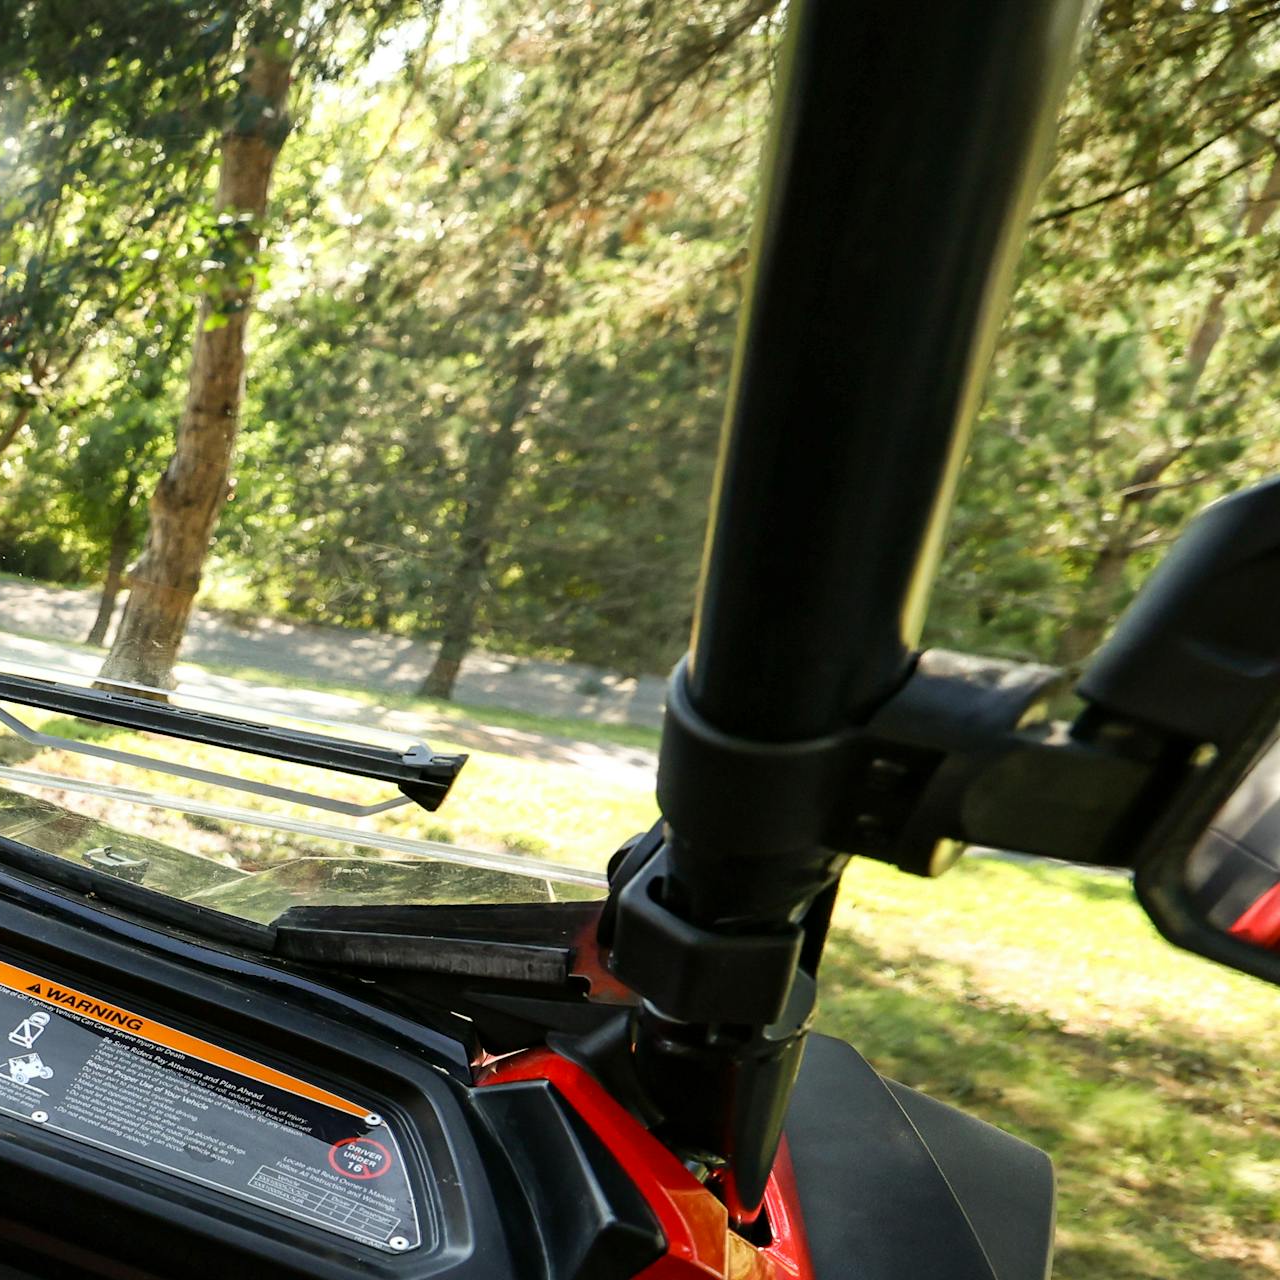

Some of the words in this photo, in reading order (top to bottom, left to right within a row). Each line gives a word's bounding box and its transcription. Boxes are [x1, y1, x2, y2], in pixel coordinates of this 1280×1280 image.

[45, 987, 145, 1032] WARNING
[55, 1007, 82, 1020] Vehicles
[81, 1017, 95, 1025] Can
[94, 1022, 115, 1033] Cause
[114, 1030, 137, 1042] Severe
[135, 1038, 156, 1050] Injury
[164, 1049, 186, 1060] Death
[85, 1059, 115, 1075] Require
[113, 1070, 139, 1084] Proper
[139, 1080, 155, 1089] Use
[153, 1085, 165, 1093] of
[163, 1089, 182, 1100] Your
[181, 1096, 209, 1111] Vehicle
[103, 1036, 114, 1044] Be
[113, 1040, 131, 1050] Sure
[130, 1047, 154, 1059] Riders
[153, 1055, 169, 1066] Pay
[168, 1060, 204, 1078] Attention
[203, 1074, 219, 1084] and
[219, 1080, 237, 1090] Plan
[237, 1086, 264, 1100] Ahead
[103, 1045, 116, 1053] you
[151, 1062, 163, 1070] the
[183, 1075, 197, 1084] may
[197, 1080, 208, 1088] tip
[228, 1091, 251, 1103] reduce
[250, 1101, 266, 1110] your
[266, 1105, 278, 1113] risk
[118, 1057, 132, 1065] firm
[130, 1062, 145, 1071] grip
[154, 1070, 165, 1078] the
[164, 1075, 191, 1088] steering
[190, 1084, 210, 1095] wheel
[251, 1107, 265, 1115] and
[265, 1112, 285, 1123] brace
[73, 1083, 84, 1091] Do
[82, 1087, 95, 1095] not
[176, 1124, 196, 1136] using
[194, 1131, 220, 1144] alcohol
[104, 1058, 116, 1066] not
[114, 1063, 127, 1071] put
[137, 1071, 152, 1081] part
[158, 1080, 174, 1089] your
[173, 1085, 190, 1095] body
[190, 1091, 215, 1103] outside
[222, 1103, 234, 1111] the
[234, 1107, 257, 1120] vehicle
[257, 1116, 268, 1124] for
[266, 1121, 279, 1129] any
[187, 1143, 211, 1156] vehicle
[283, 1156, 307, 1169] Locate
[306, 1165, 321, 1174] and
[320, 1170, 339, 1181] Read
[343, 1151, 377, 1168] UNDER
[346, 1161, 364, 1173] 16
[347, 1144, 383, 1161] DRIVER
[276, 1161, 298, 1173] Follow
[298, 1170, 310, 1178] All
[309, 1174, 347, 1192] Instruction
[347, 1189, 362, 1198] and
